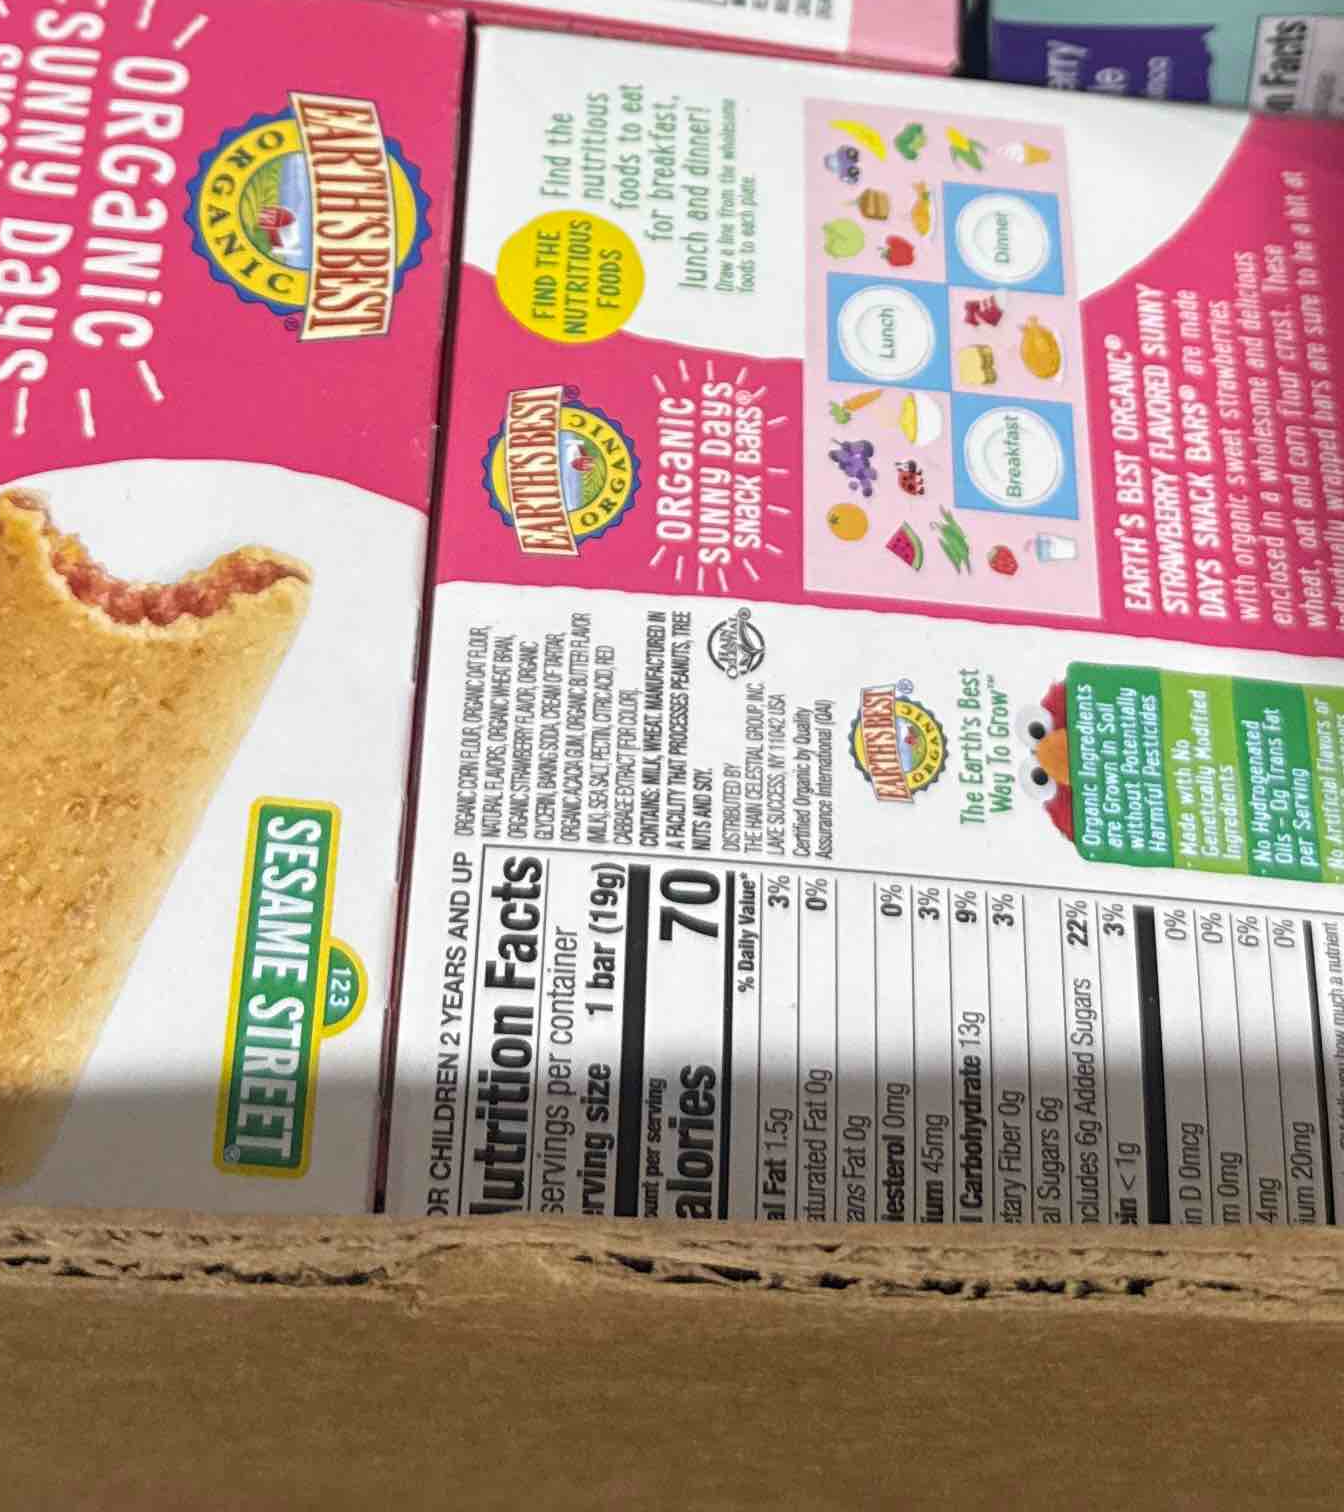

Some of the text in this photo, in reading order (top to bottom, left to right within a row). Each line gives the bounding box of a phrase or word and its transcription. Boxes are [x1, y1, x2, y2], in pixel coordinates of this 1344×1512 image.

[540, 112, 574, 200] Find the
[578, 91, 608, 201] nutritious
[612, 83, 644, 212] foods to eat
[679, 104, 712, 290] lunch and dinner!
[207, 131, 295, 295] ORGANIC
[299, 101, 391, 332] EARTH'S BEST
[647, 209, 675, 241] for
[991, 210, 1013, 266] Dinner
[531, 230, 562, 320] FIND THE
[563, 219, 594, 336] NUTRITIOUS
[597, 248, 624, 311] FOODS
[876, 306, 898, 361] Lunch
[508, 387, 574, 552] EARTH'S BEST
[565, 412, 628, 528] ORGANIC
[1001, 414, 1024, 499] Breakfast
[1115, 450, 1148, 505] BEST
[1135, 283, 1190, 615] STRAWBERRY FLAVORED SUNNY
[1115, 514, 1154, 610] EARTH'S
[1187, 472, 1223, 548] SNACK
[1194, 558, 1228, 620] DAYS
[955, 667, 986, 825] The Earth's Best
[986, 743, 1012, 765] To
[988, 771, 1016, 814] Way
[250, 815, 322, 982] SESAME
[482, 855, 545, 992] Facts
[328, 967, 353, 1008] 123
[429, 851, 474, 1181] CHILDREN 2 YEARS AND UP
[546, 925, 579, 1045] container
[581, 861, 627, 1124] size 1 bar (19g)
[235, 994, 305, 1161] STREET
[658, 868, 721, 1221] alories 70
